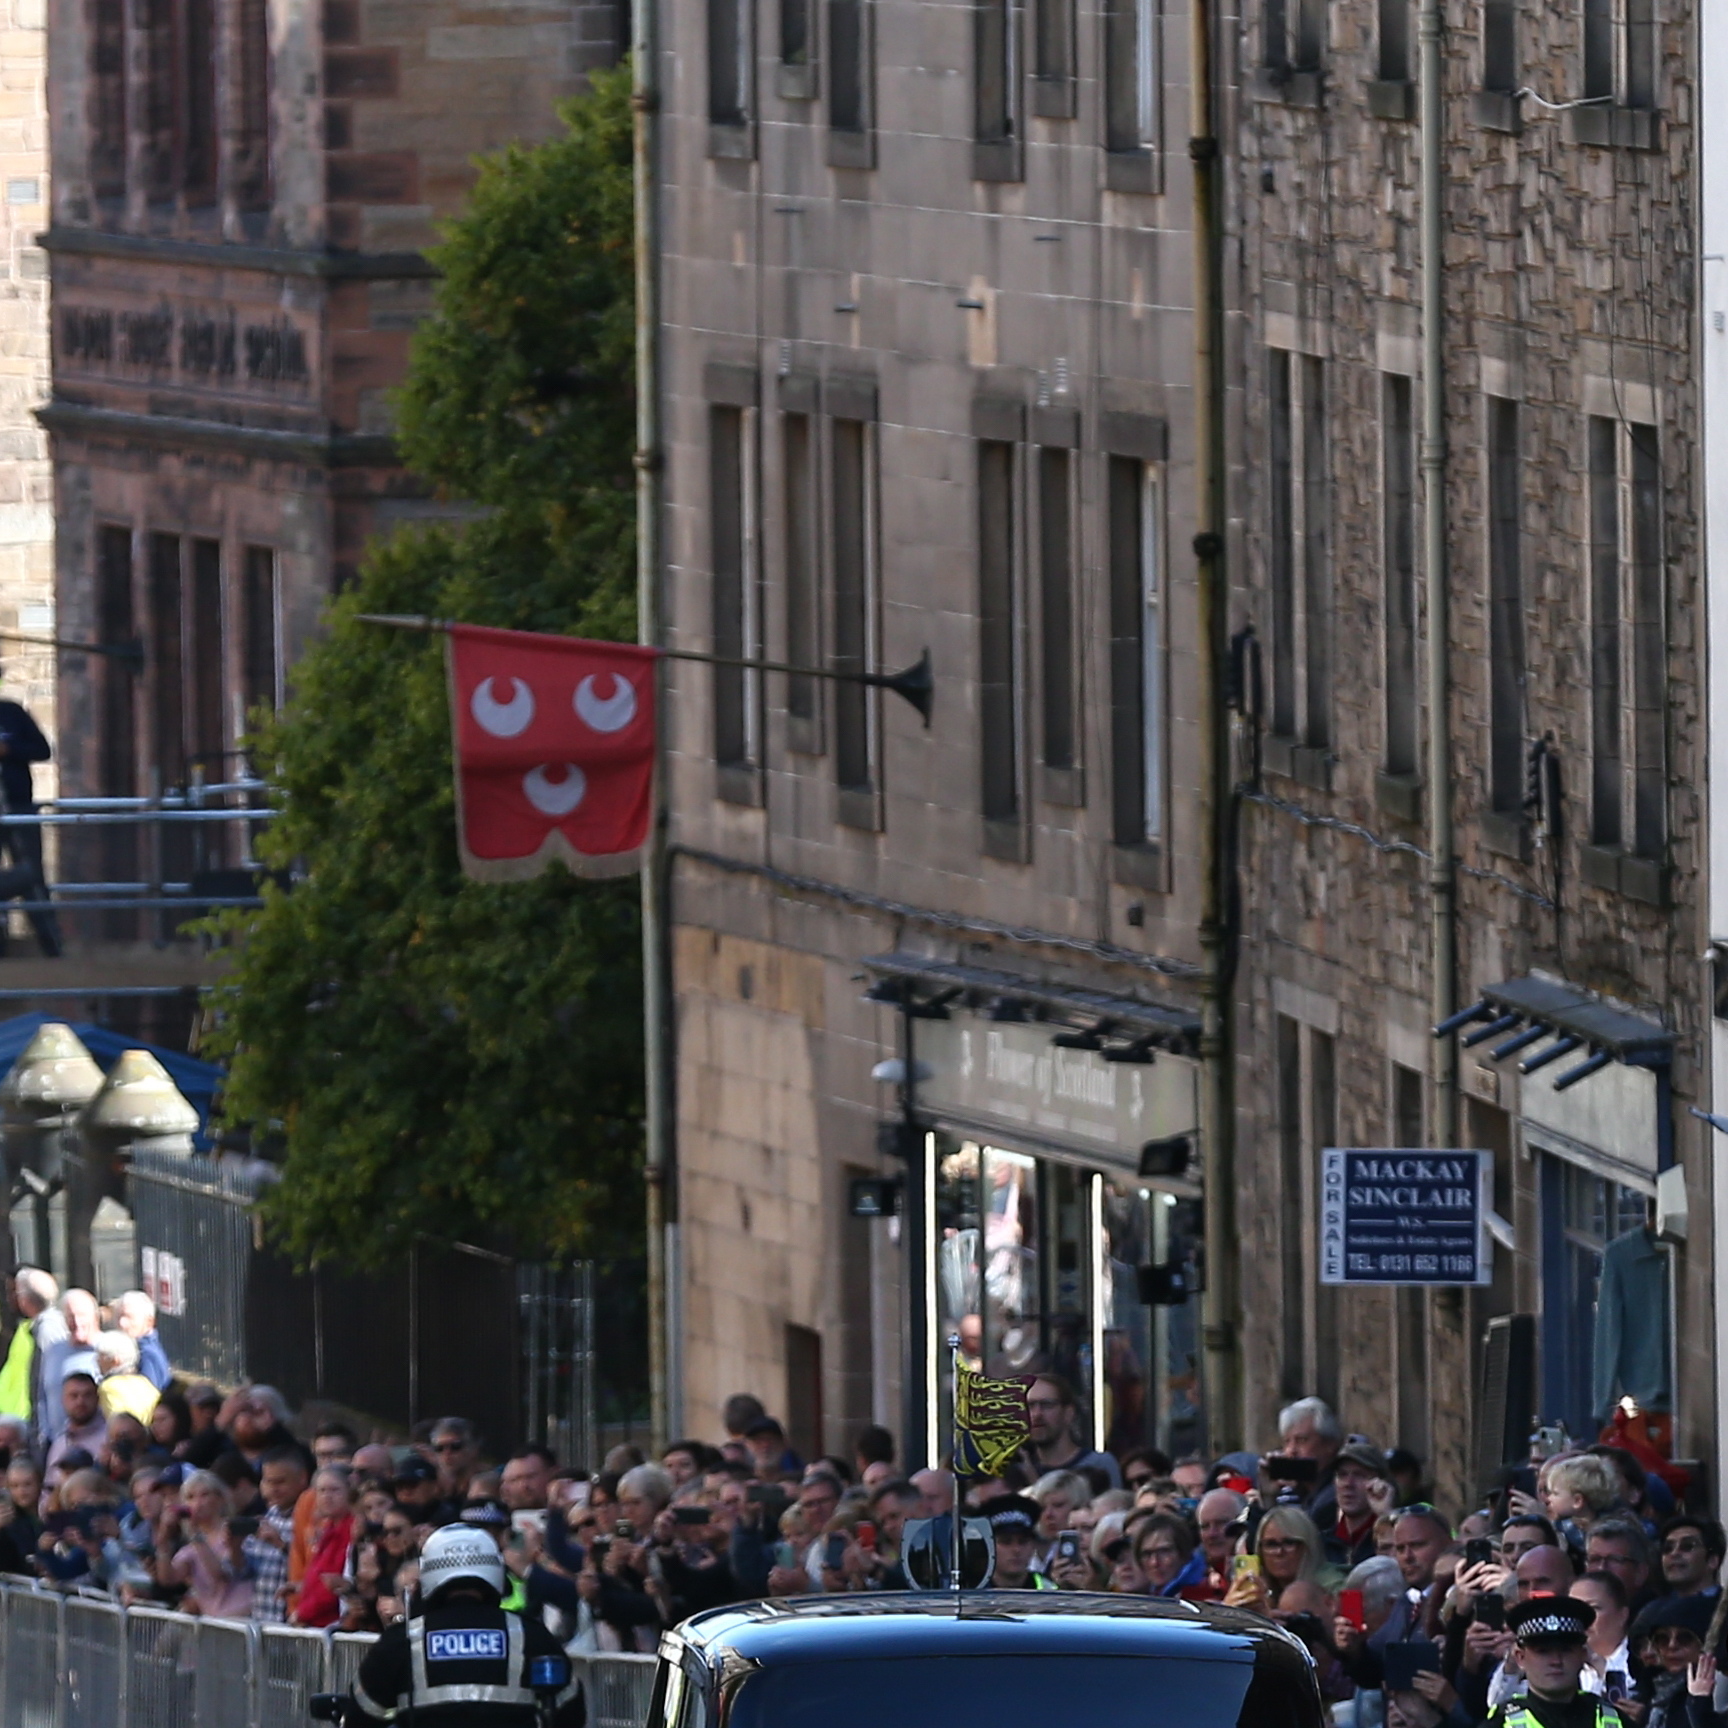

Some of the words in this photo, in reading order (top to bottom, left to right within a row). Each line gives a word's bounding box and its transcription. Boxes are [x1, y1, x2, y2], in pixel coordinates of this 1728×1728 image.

[1325, 1154, 1341, 1202] FOR
[1354, 1159, 1469, 1182] MACKAY
[1348, 1186, 1472, 1208] SINCLAIR
[1325, 1210, 1341, 1275] SALE
[443, 1544, 481, 1556] POLICE
[431, 1632, 502, 1655] POLICE
